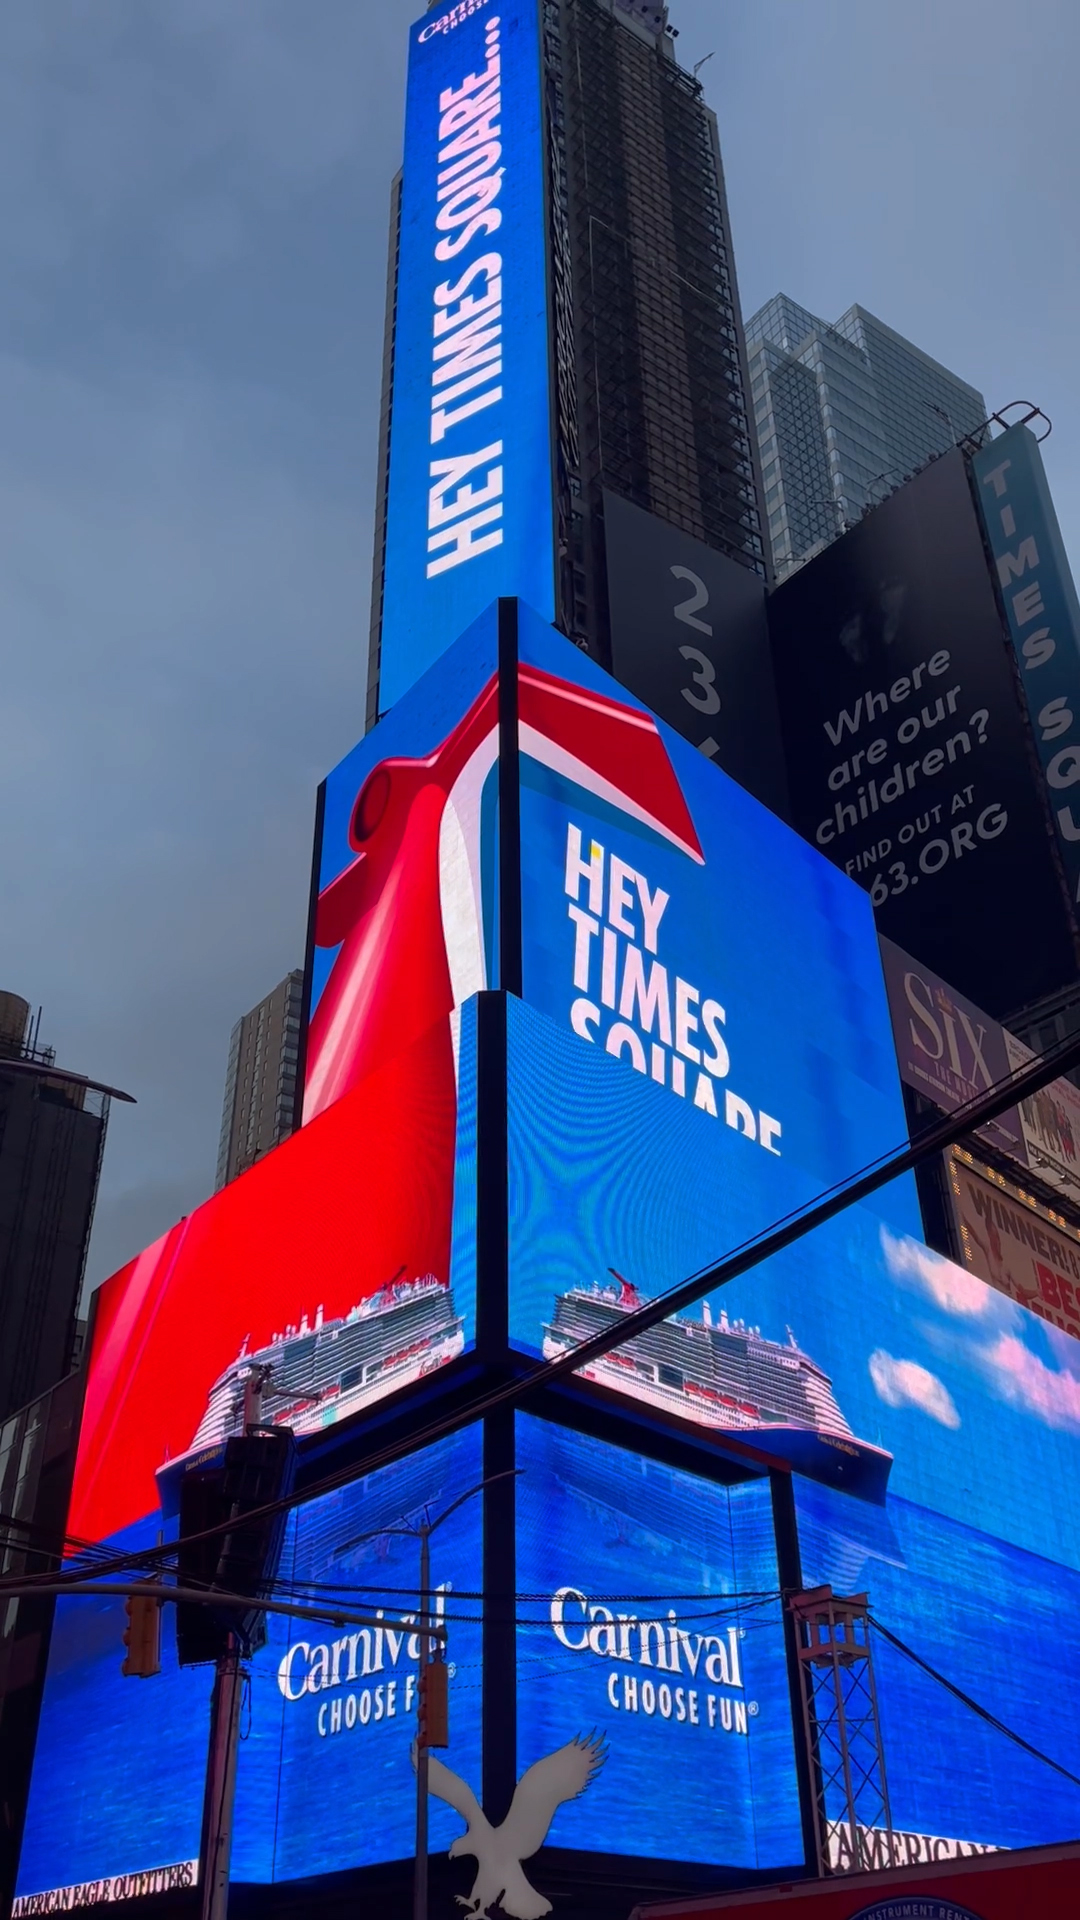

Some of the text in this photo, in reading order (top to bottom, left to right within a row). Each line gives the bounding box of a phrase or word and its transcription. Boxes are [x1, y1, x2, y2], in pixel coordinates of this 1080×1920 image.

[418, 0, 477, 43] Carn
[430, 251, 503, 444] TIMES
[426, 440, 503, 579] HEY
[983, 458, 1056, 670] TIMES
[669, 564, 721, 759] 23
[823, 649, 951, 746] Where
[816, 708, 990, 844] children?
[828, 685, 961, 791] are our
[845, 784, 975, 876] FIND OUT AT
[564, 822, 670, 955] HEY
[568, 902, 730, 1079] TIMES
[966, 1182, 1070, 1275] WINNER!
[1036, 1261, 1080, 1323] BE
[318, 1683, 398, 1737] CHOOSE
[607, 1672, 699, 1725] CHOOSE
[11, 1862, 193, 1919] AMERICAN EAGLE OUTFITTERS
[863, 1904, 934, 1920] NSTRUMENT
